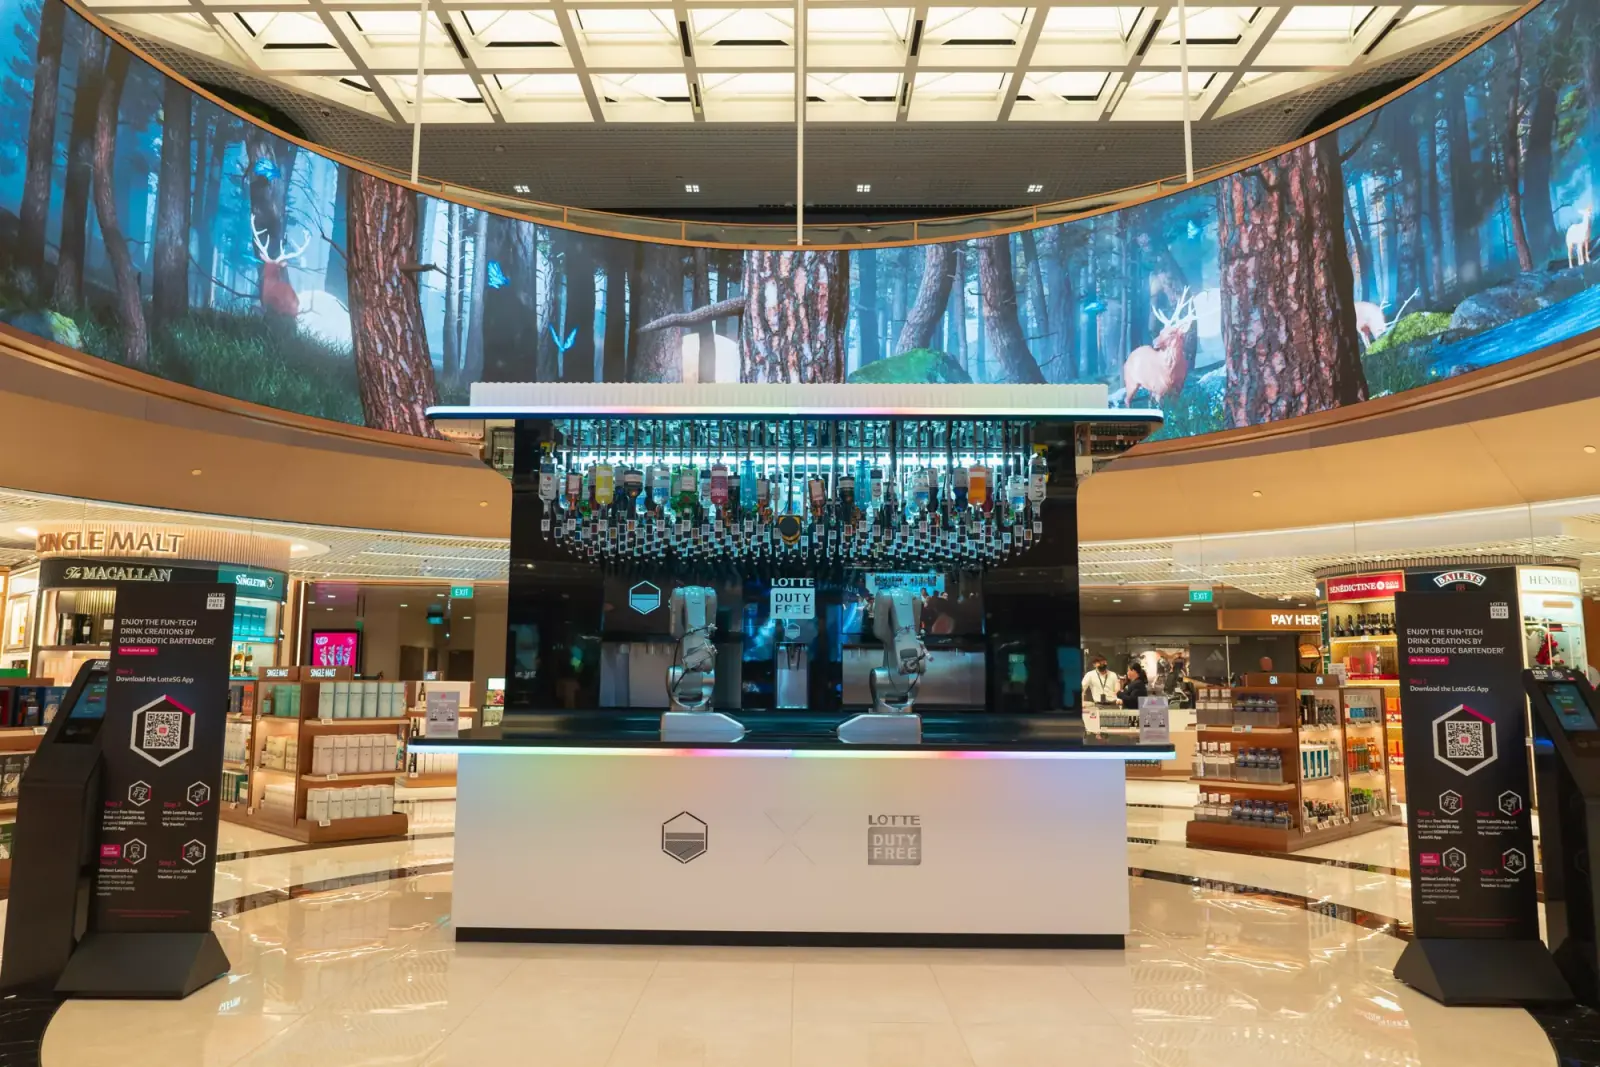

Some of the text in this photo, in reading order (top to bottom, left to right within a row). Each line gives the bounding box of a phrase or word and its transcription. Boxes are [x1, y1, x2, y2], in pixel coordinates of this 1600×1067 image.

[110, 532, 184, 552] MALT
[63, 566, 172, 582] The MACALLAN
[1438, 571, 1482, 584] BAILEYS
[235, 574, 267, 588] SINGLETON
[771, 578, 815, 587] LOTTE
[454, 588, 469, 597] EXIT
[1193, 592, 1209, 600] EXIT
[775, 593, 811, 603] DUTY
[775, 605, 811, 614] FREE
[121, 618, 144, 626] ENJOY
[1270, 614, 1320, 625] PAY HER
[144, 628, 184, 636] CREATIONS
[1406, 628, 1484, 636] ENJOY THE FUN-TECH
[136, 637, 168, 645] ROBOTIC
[310, 668, 325, 677] SINGLE
[868, 815, 921, 825] LOTTE
[873, 834, 917, 846] DUTY
[873, 847, 917, 860] FREE
